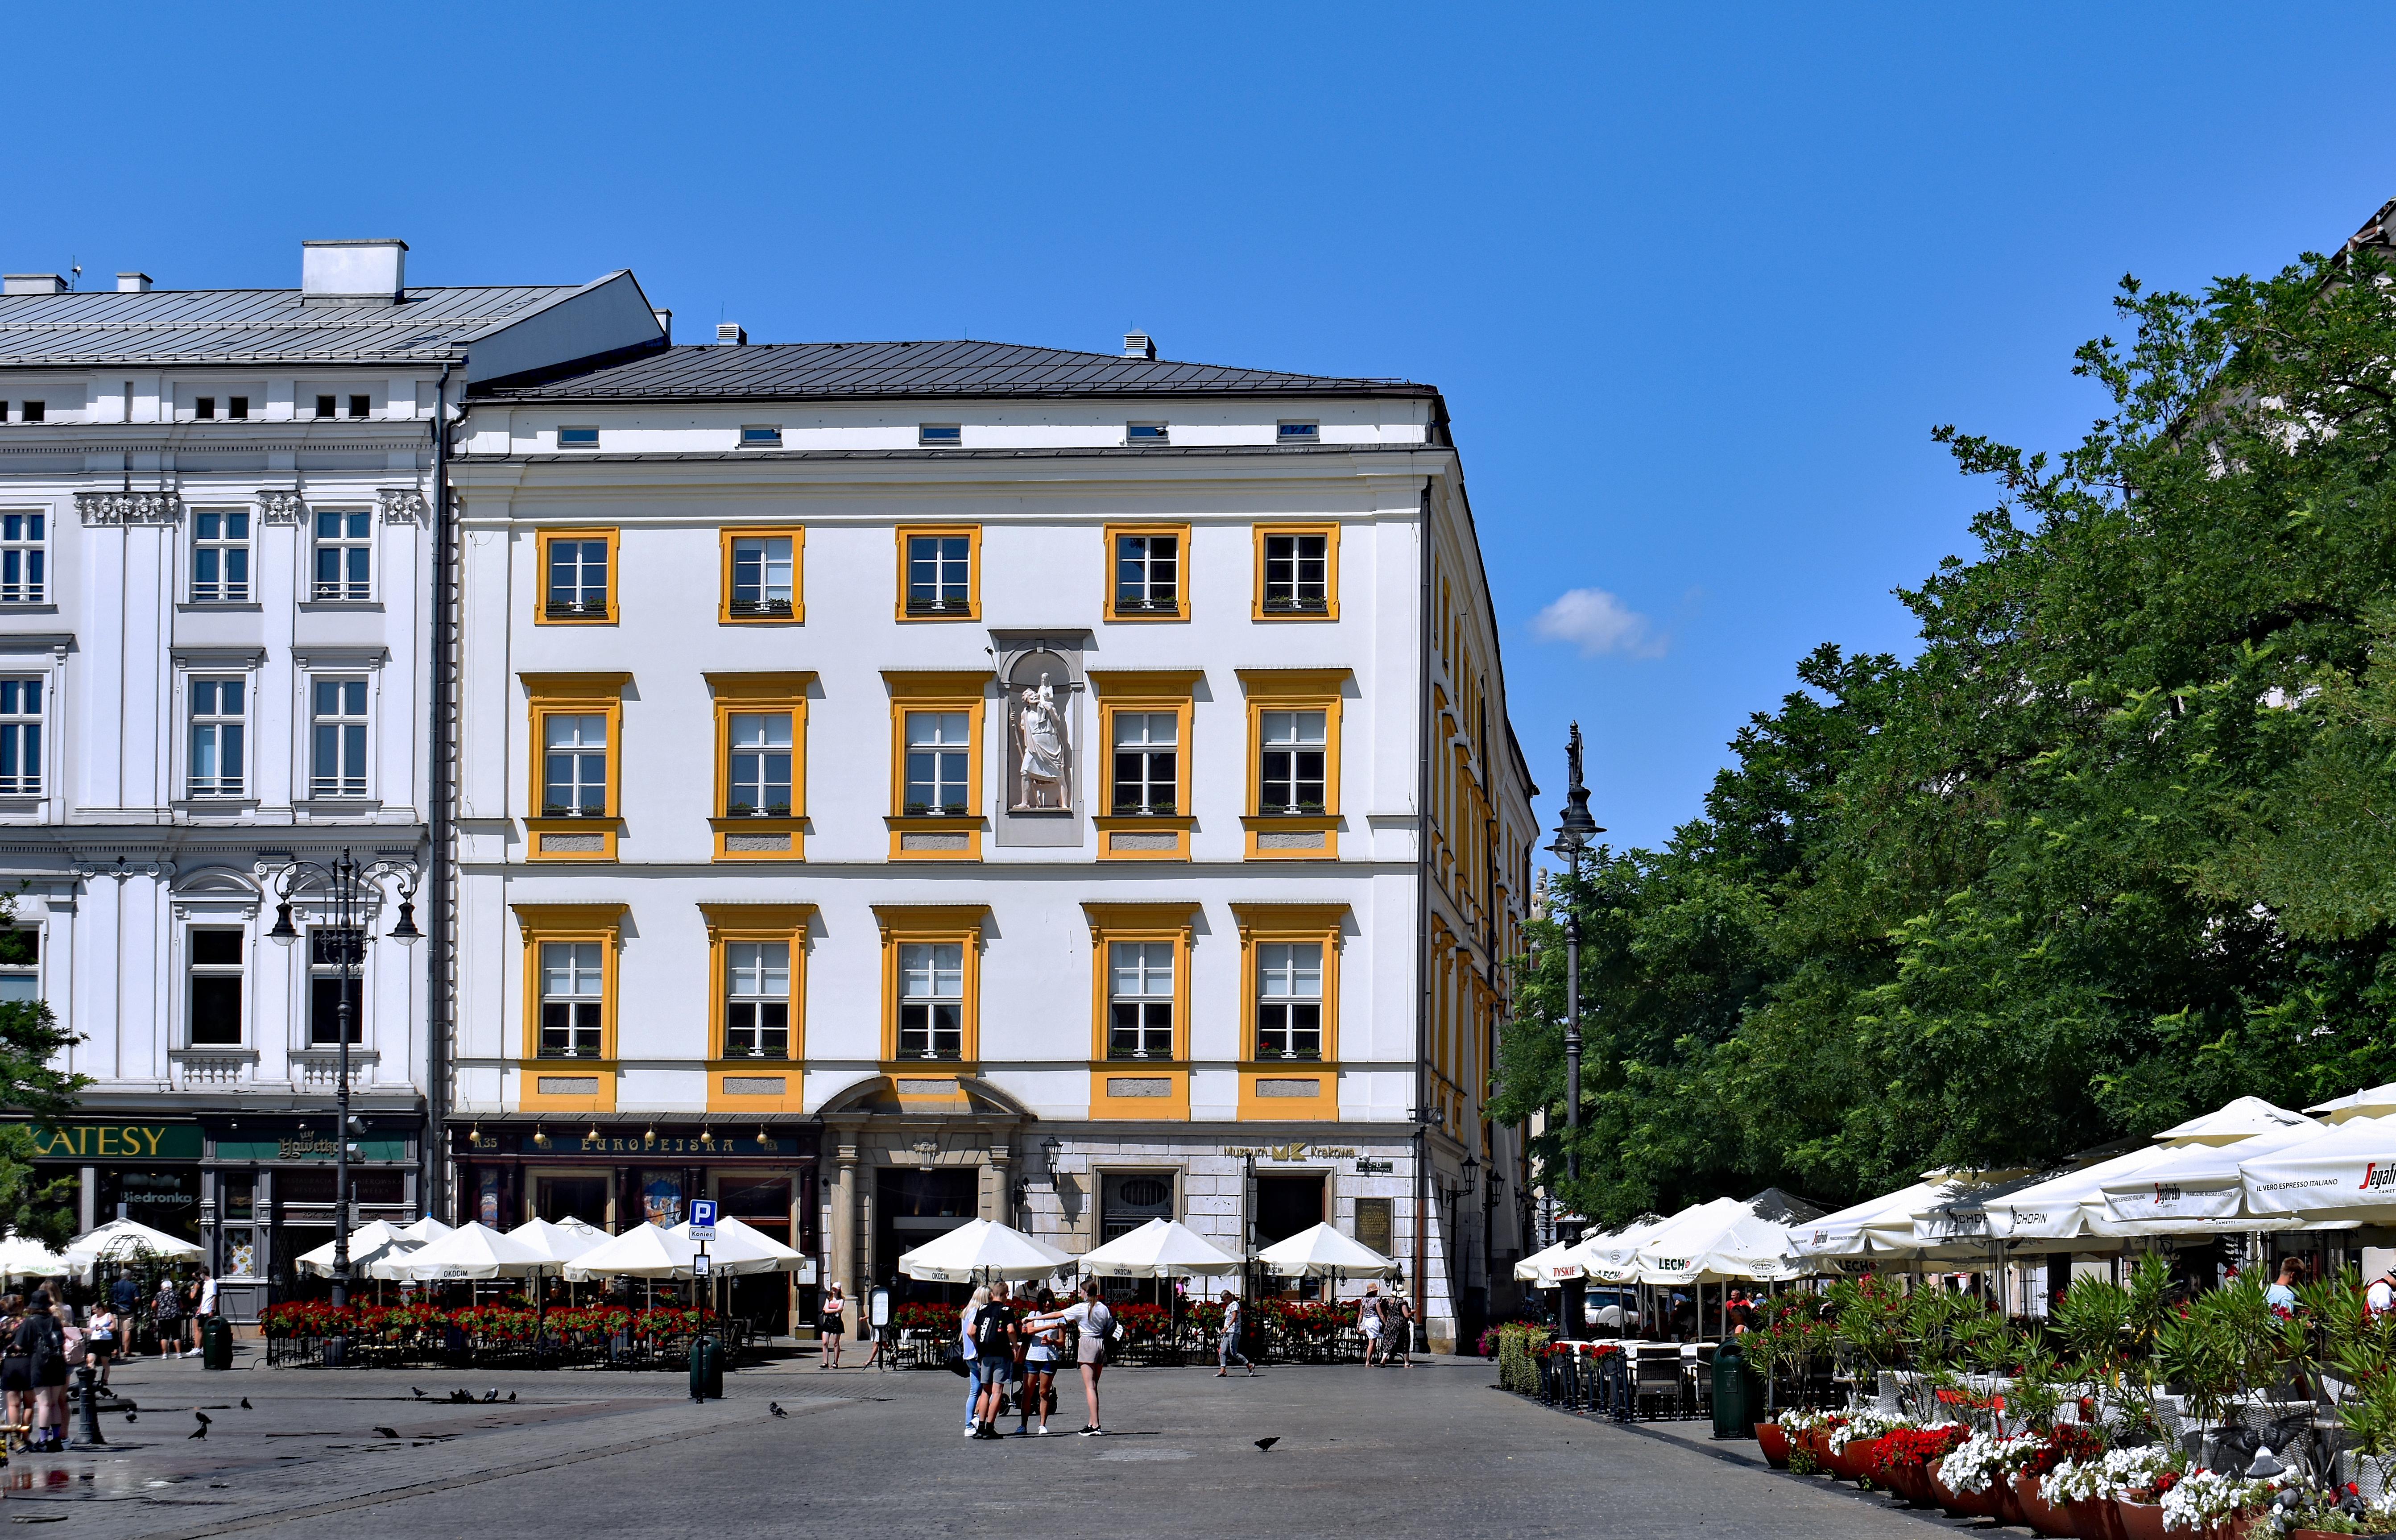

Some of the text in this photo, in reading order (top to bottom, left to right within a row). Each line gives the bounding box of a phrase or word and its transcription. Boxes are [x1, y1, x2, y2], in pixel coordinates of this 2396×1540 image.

[581, 1138, 734, 1151] EUROPEJSKA
[1224, 1145, 1268, 1157] Muzeum
[1311, 1146, 1355, 1158] Krakowa
[2359, 1162, 2396, 1189] Segafr
[2279, 1180, 2308, 1189] ESPRESSO
[2309, 1179, 2338, 1187] ITALIANO
[124, 1192, 192, 1203] Biedronka
[2154, 1183, 2181, 1204] Segafredo
[695, 1203, 711, 1223] P
[1958, 1213, 1988, 1224] CHOP
[2016, 1213, 2048, 1224] CHOPIN
[1659, 1258, 1685, 1271] LECH
[1839, 1260, 1869, 1271] LECH
[1552, 1266, 1575, 1277] TYSKIE
[980, 1317, 990, 1342] adidas
